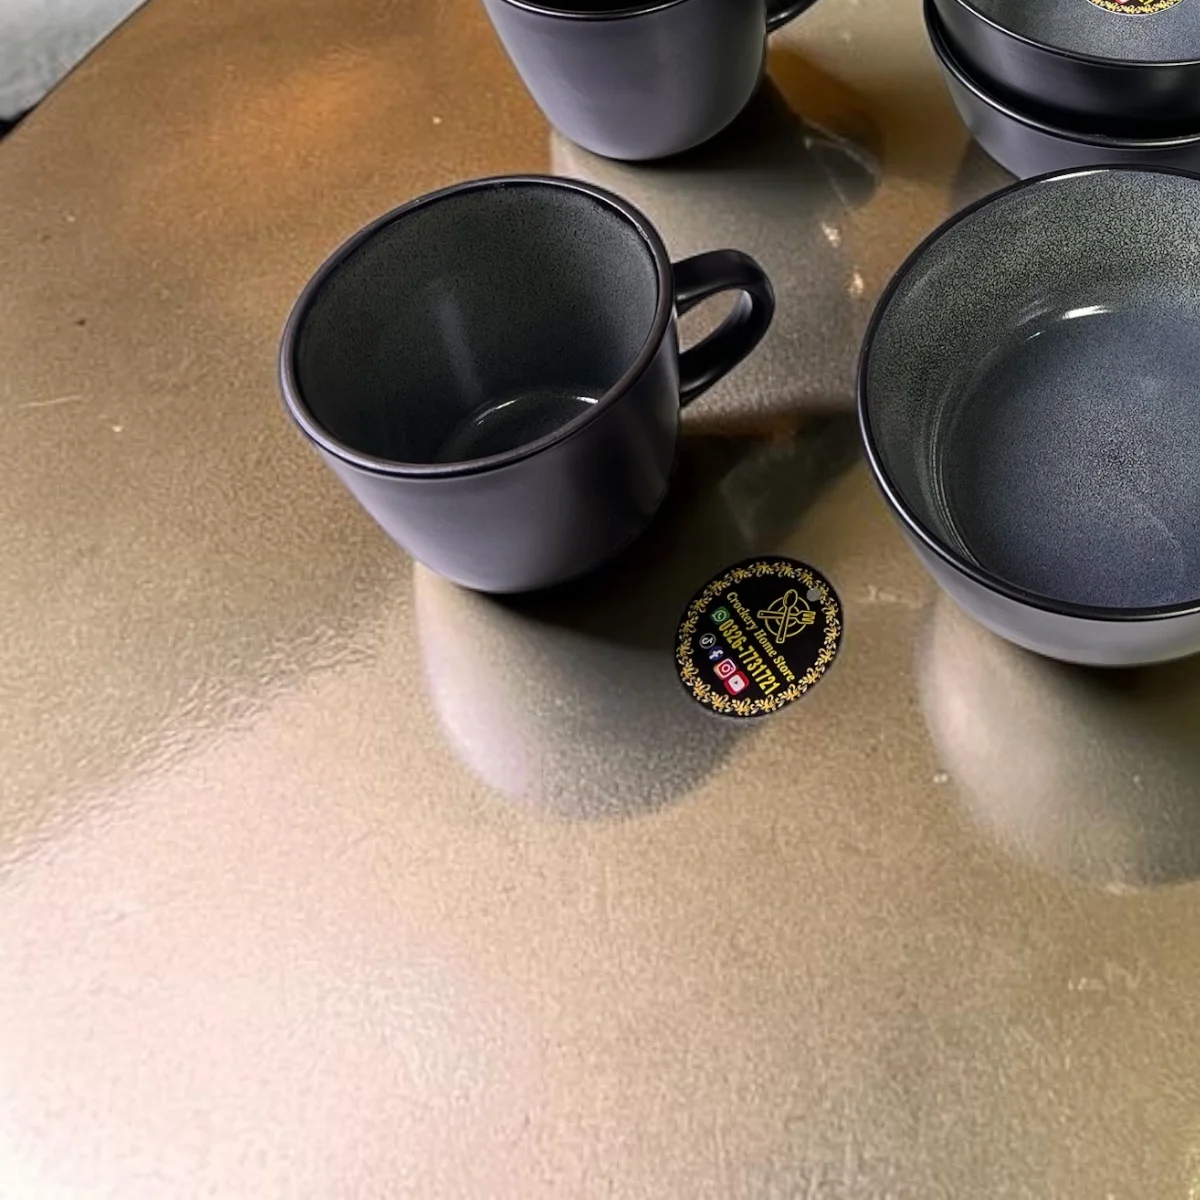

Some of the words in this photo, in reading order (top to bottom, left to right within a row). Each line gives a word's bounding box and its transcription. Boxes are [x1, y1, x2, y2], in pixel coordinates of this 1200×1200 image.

[718, 618, 781, 695] 0326-7731721
[727, 592, 758, 631] Crockery
[754, 629, 776, 657] Home
[773, 656, 795, 682] Store
